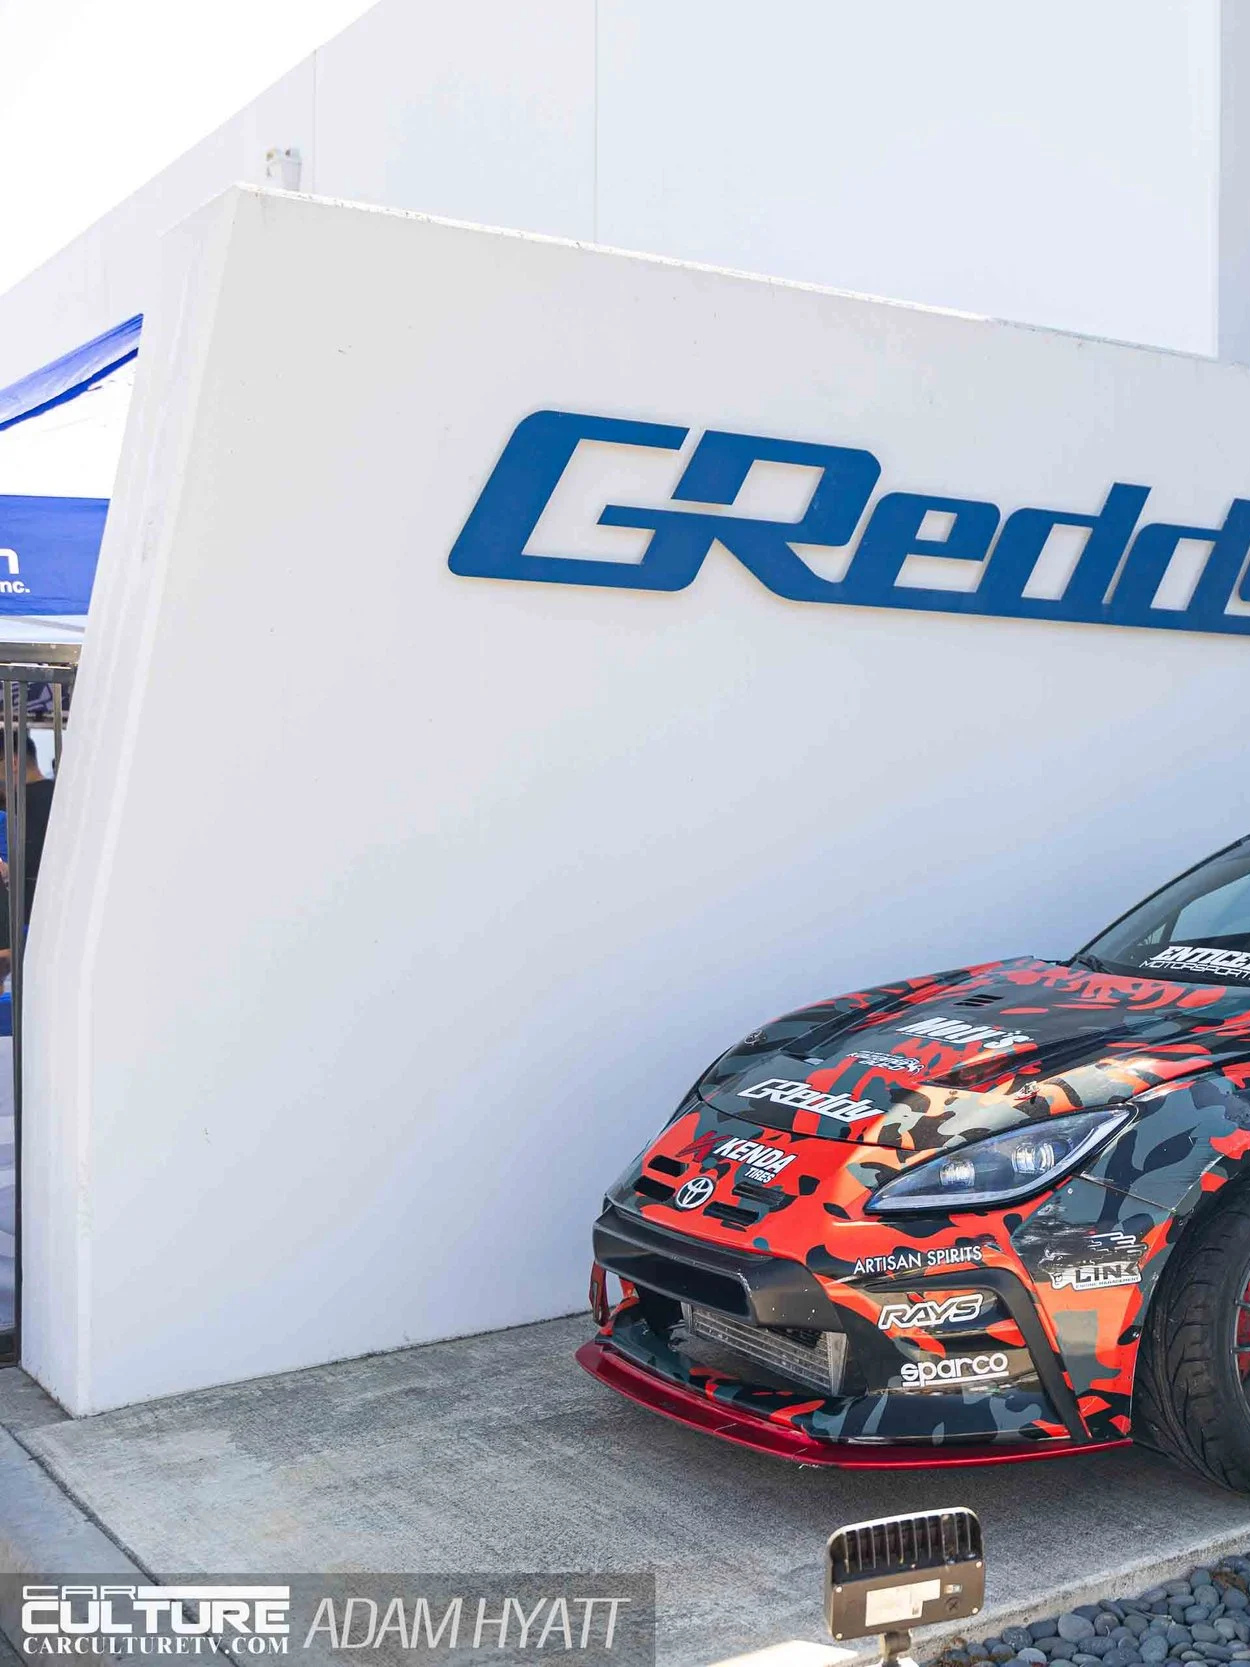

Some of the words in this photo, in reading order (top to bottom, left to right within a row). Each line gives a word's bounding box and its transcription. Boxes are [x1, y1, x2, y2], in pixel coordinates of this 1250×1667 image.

[737, 1078, 885, 1122] GReddy
[713, 1137, 798, 1173] KENDA
[745, 1166, 776, 1183] TIRES
[854, 1252, 921, 1275] ARTISAN
[927, 1245, 982, 1265] SPIRITS
[878, 1294, 983, 1330] RAYS
[901, 1352, 1008, 1387] sparco
